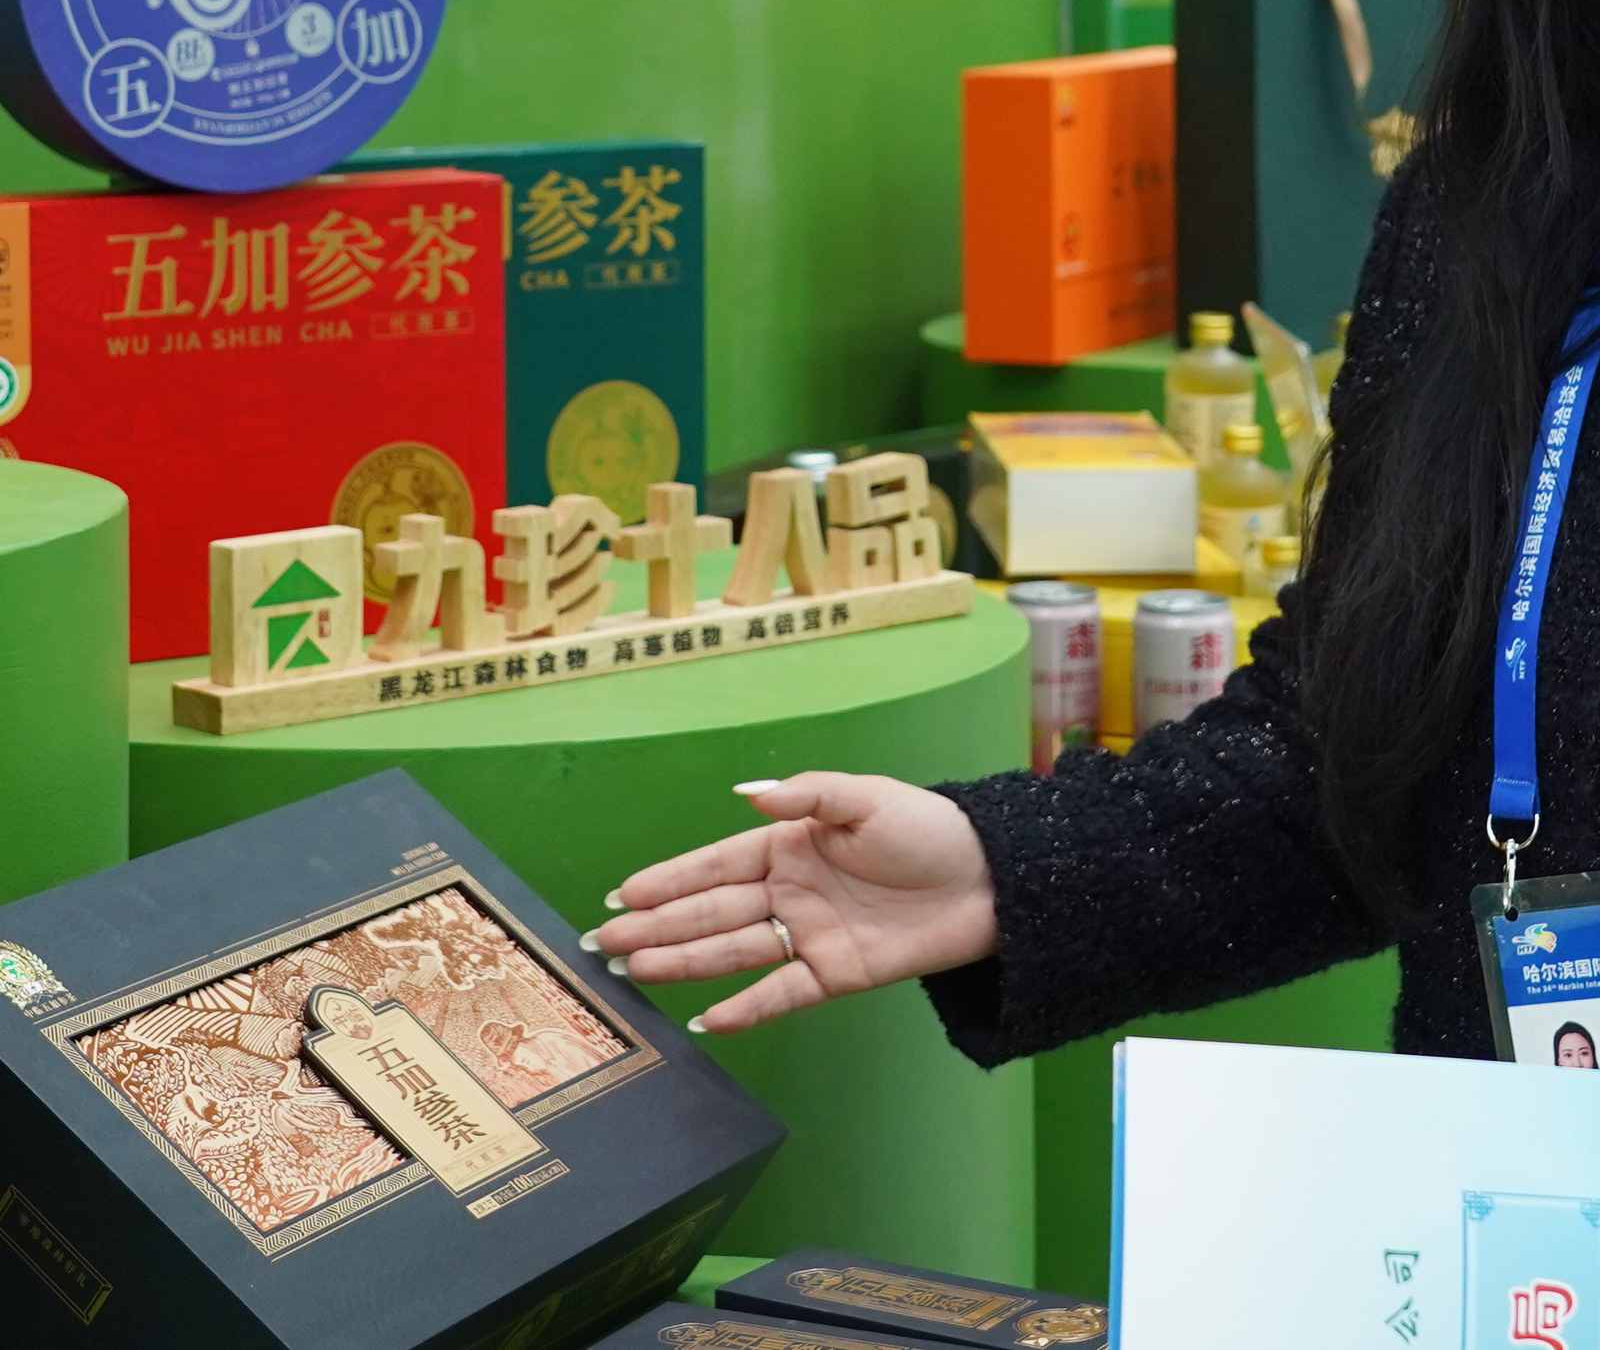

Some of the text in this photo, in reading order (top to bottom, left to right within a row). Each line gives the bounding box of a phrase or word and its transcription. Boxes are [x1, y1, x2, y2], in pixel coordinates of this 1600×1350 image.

[351, 8, 408, 66] 加
[101, 59, 161, 122] 五
[505, 166, 682, 264] 参茶
[104, 203, 477, 321] 五加参茶
[520, 270, 569, 290] CHA
[106, 321, 353, 358] WU JIA SHEN CHA
[1512, 364, 1584, 621] 哈尔滨国际经济贸易洽谈会
[366, 451, 944, 662] 九珍十八品
[379, 647, 588, 702] 黑龙江森林食物
[613, 626, 722, 665] 高寒植物
[1558, 981, 1584, 992] Harbin
[357, 1037, 488, 1151] 五加参茶
[511, 1173, 533, 1194] 100
[1384, 1249, 1419, 1343] 公司
[1514, 1284, 1574, 1350] 局
